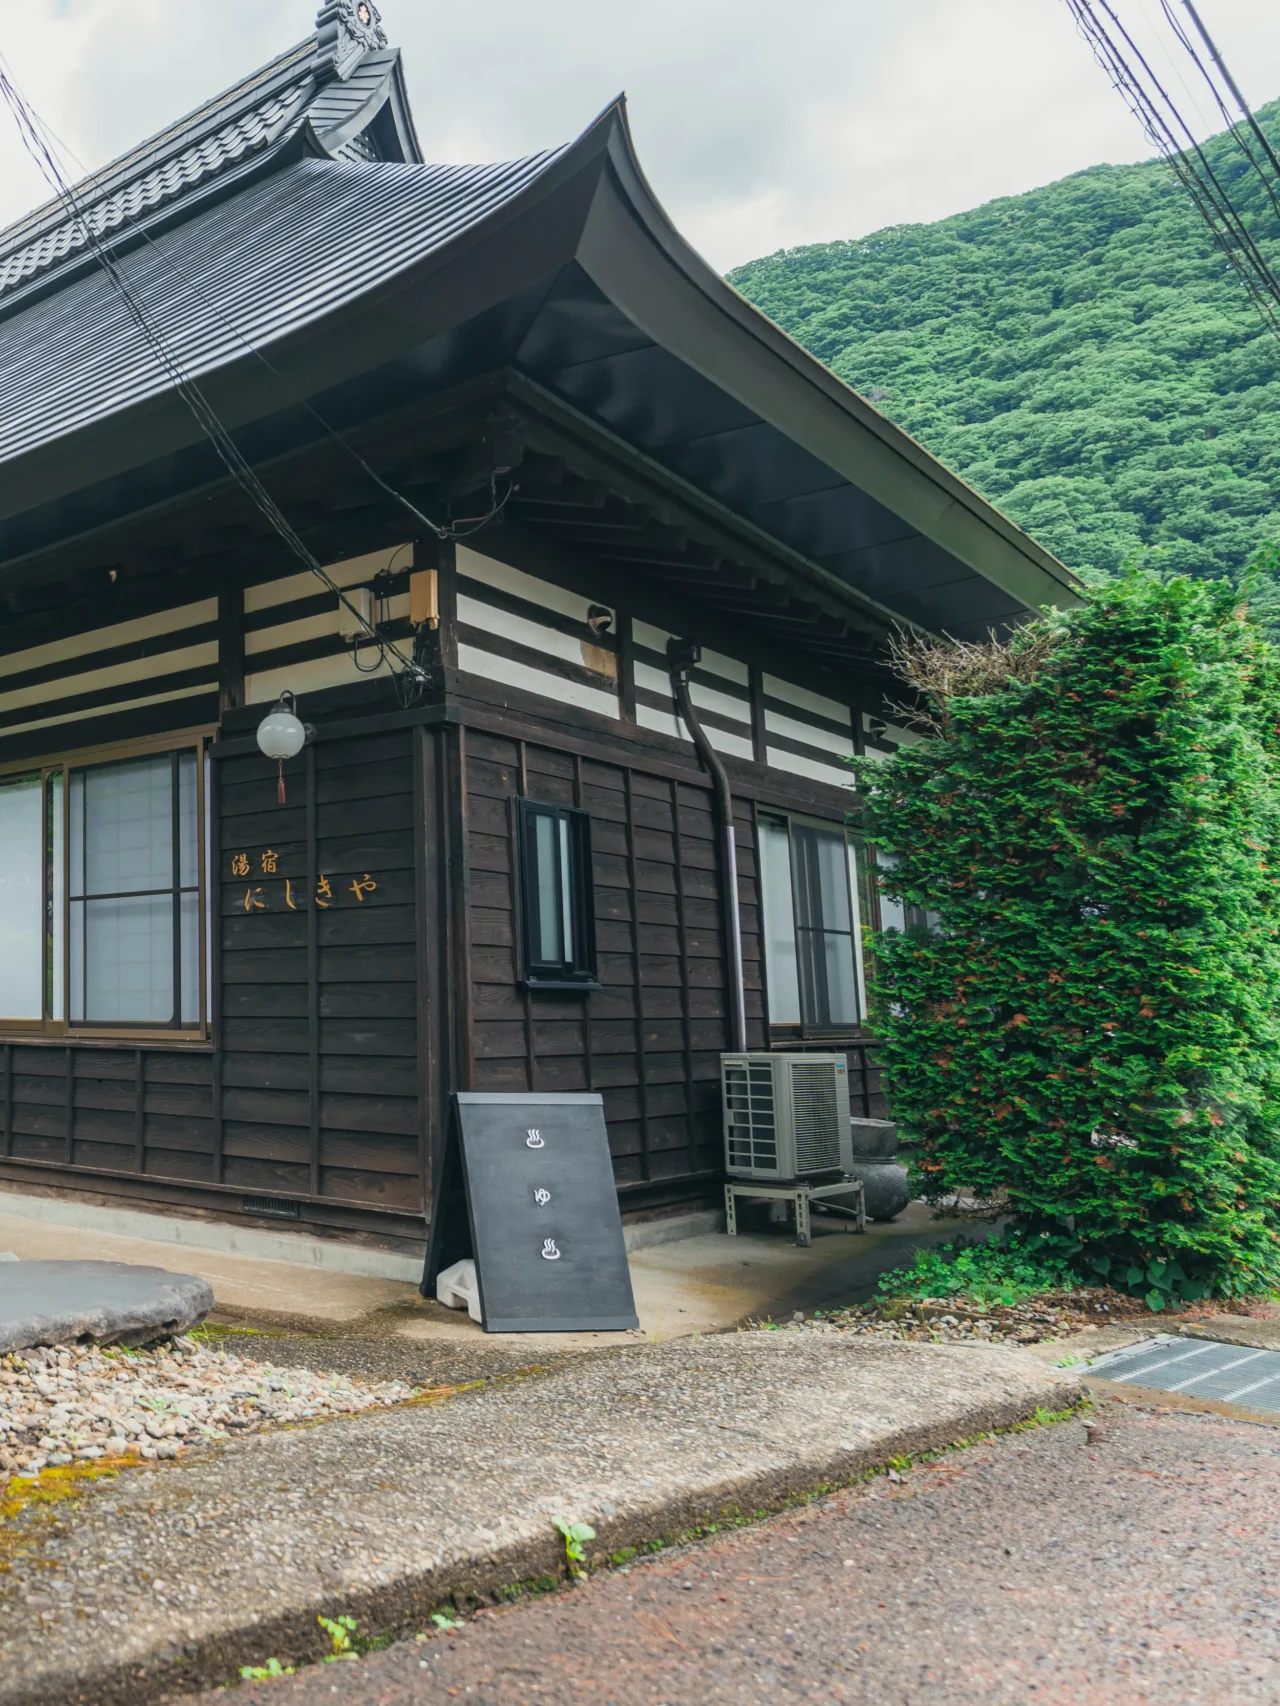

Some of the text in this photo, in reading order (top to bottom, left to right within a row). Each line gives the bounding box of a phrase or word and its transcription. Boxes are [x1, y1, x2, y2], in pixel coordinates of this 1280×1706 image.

[231, 850, 279, 876] 湯宿
[244, 874, 377, 911] にしきや
[533, 1188, 551, 1206] ゆ
